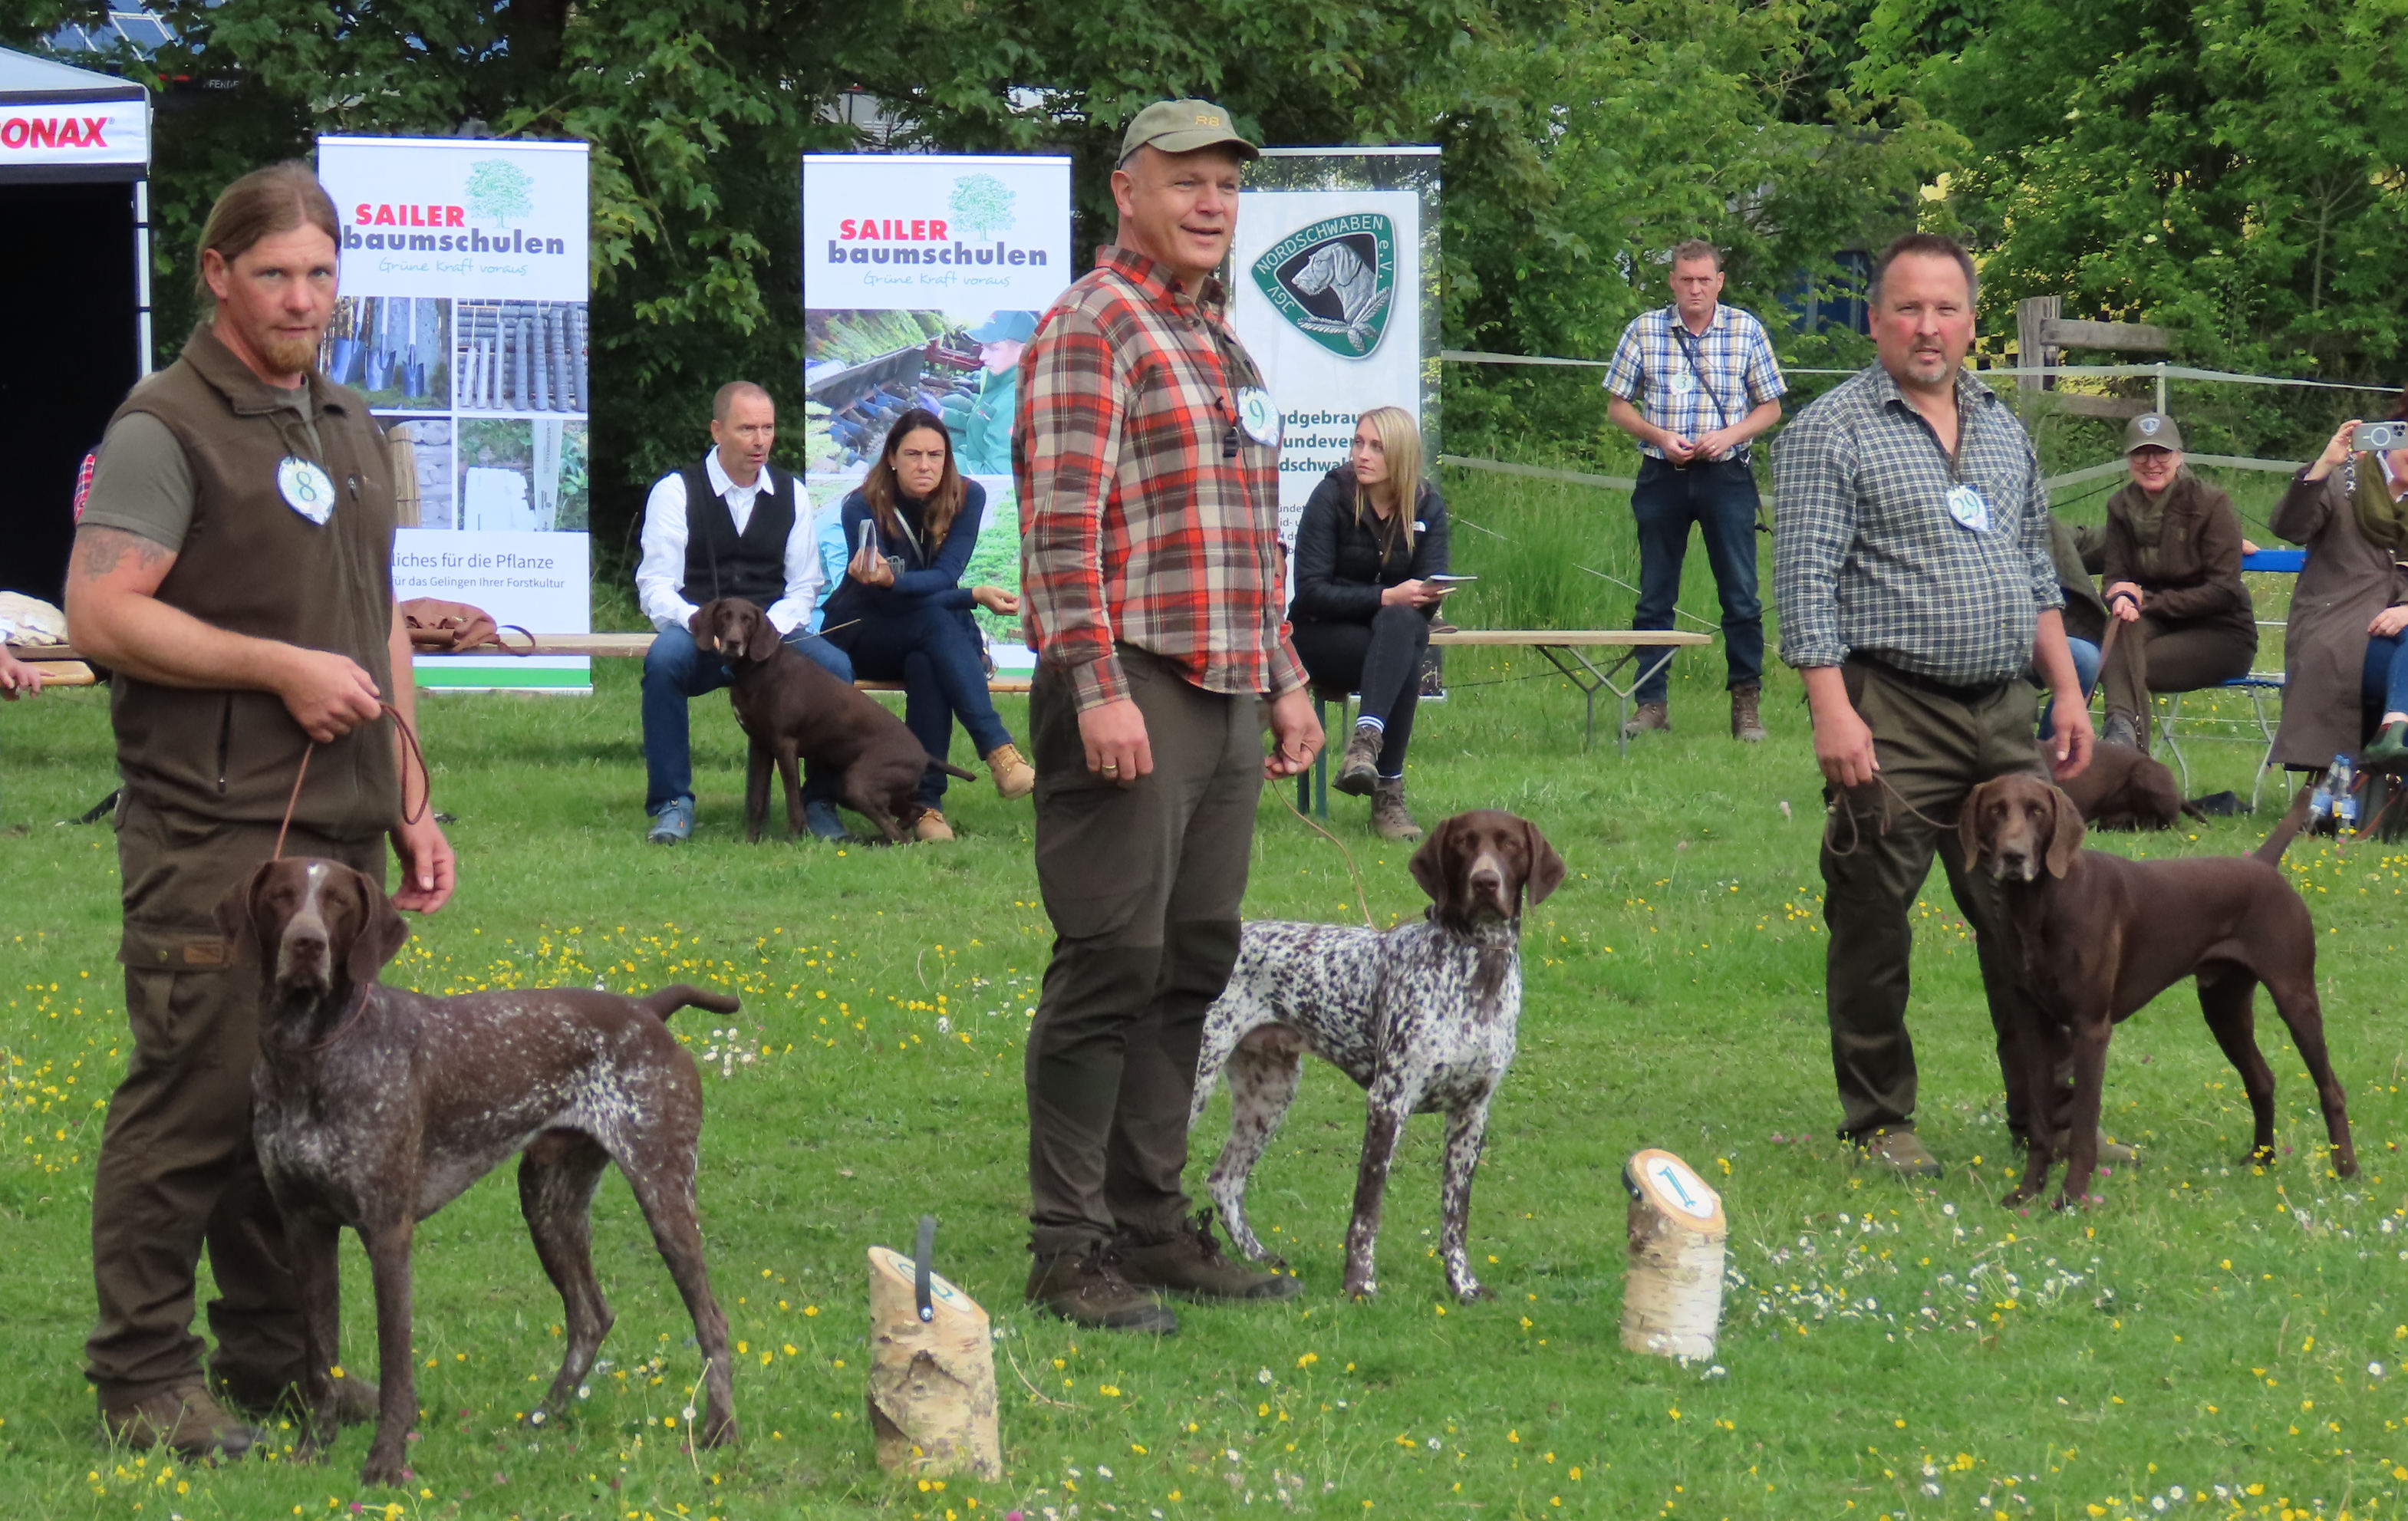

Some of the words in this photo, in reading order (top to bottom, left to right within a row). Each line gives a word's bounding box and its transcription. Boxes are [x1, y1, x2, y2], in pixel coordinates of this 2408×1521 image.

[0, 117, 109, 149] ONAX
[1194, 114, 1221, 127] R8
[355, 203, 465, 227] SAILER
[343, 225, 565, 255] baumschulen
[840, 219, 948, 241] SAILER
[828, 240, 1047, 265] baumschulen
[1256, 216, 1384, 275] NORDSCHWABEN
[379, 258, 430, 274] Grüne
[479, 263, 529, 276] voraus
[1378, 239, 1392, 279] e.V.
[864, 271, 914, 287] Grüne
[964, 275, 1012, 288] voraus
[1267, 286, 1295, 313] JGV
[1676, 376, 1688, 390] 3
[1249, 398, 1265, 429] 9
[296, 470, 317, 502] 8
[1952, 492, 1980, 521] 29
[442, 551, 464, 568] für
[468, 551, 492, 569] die
[496, 552, 555, 570] Pflanze
[408, 575, 428, 588] das
[430, 576, 476, 590] Gelingen
[479, 577, 503, 588] Ihrer
[507, 577, 565, 589] Forstkultur
[1657, 1165, 1697, 1210] 1
